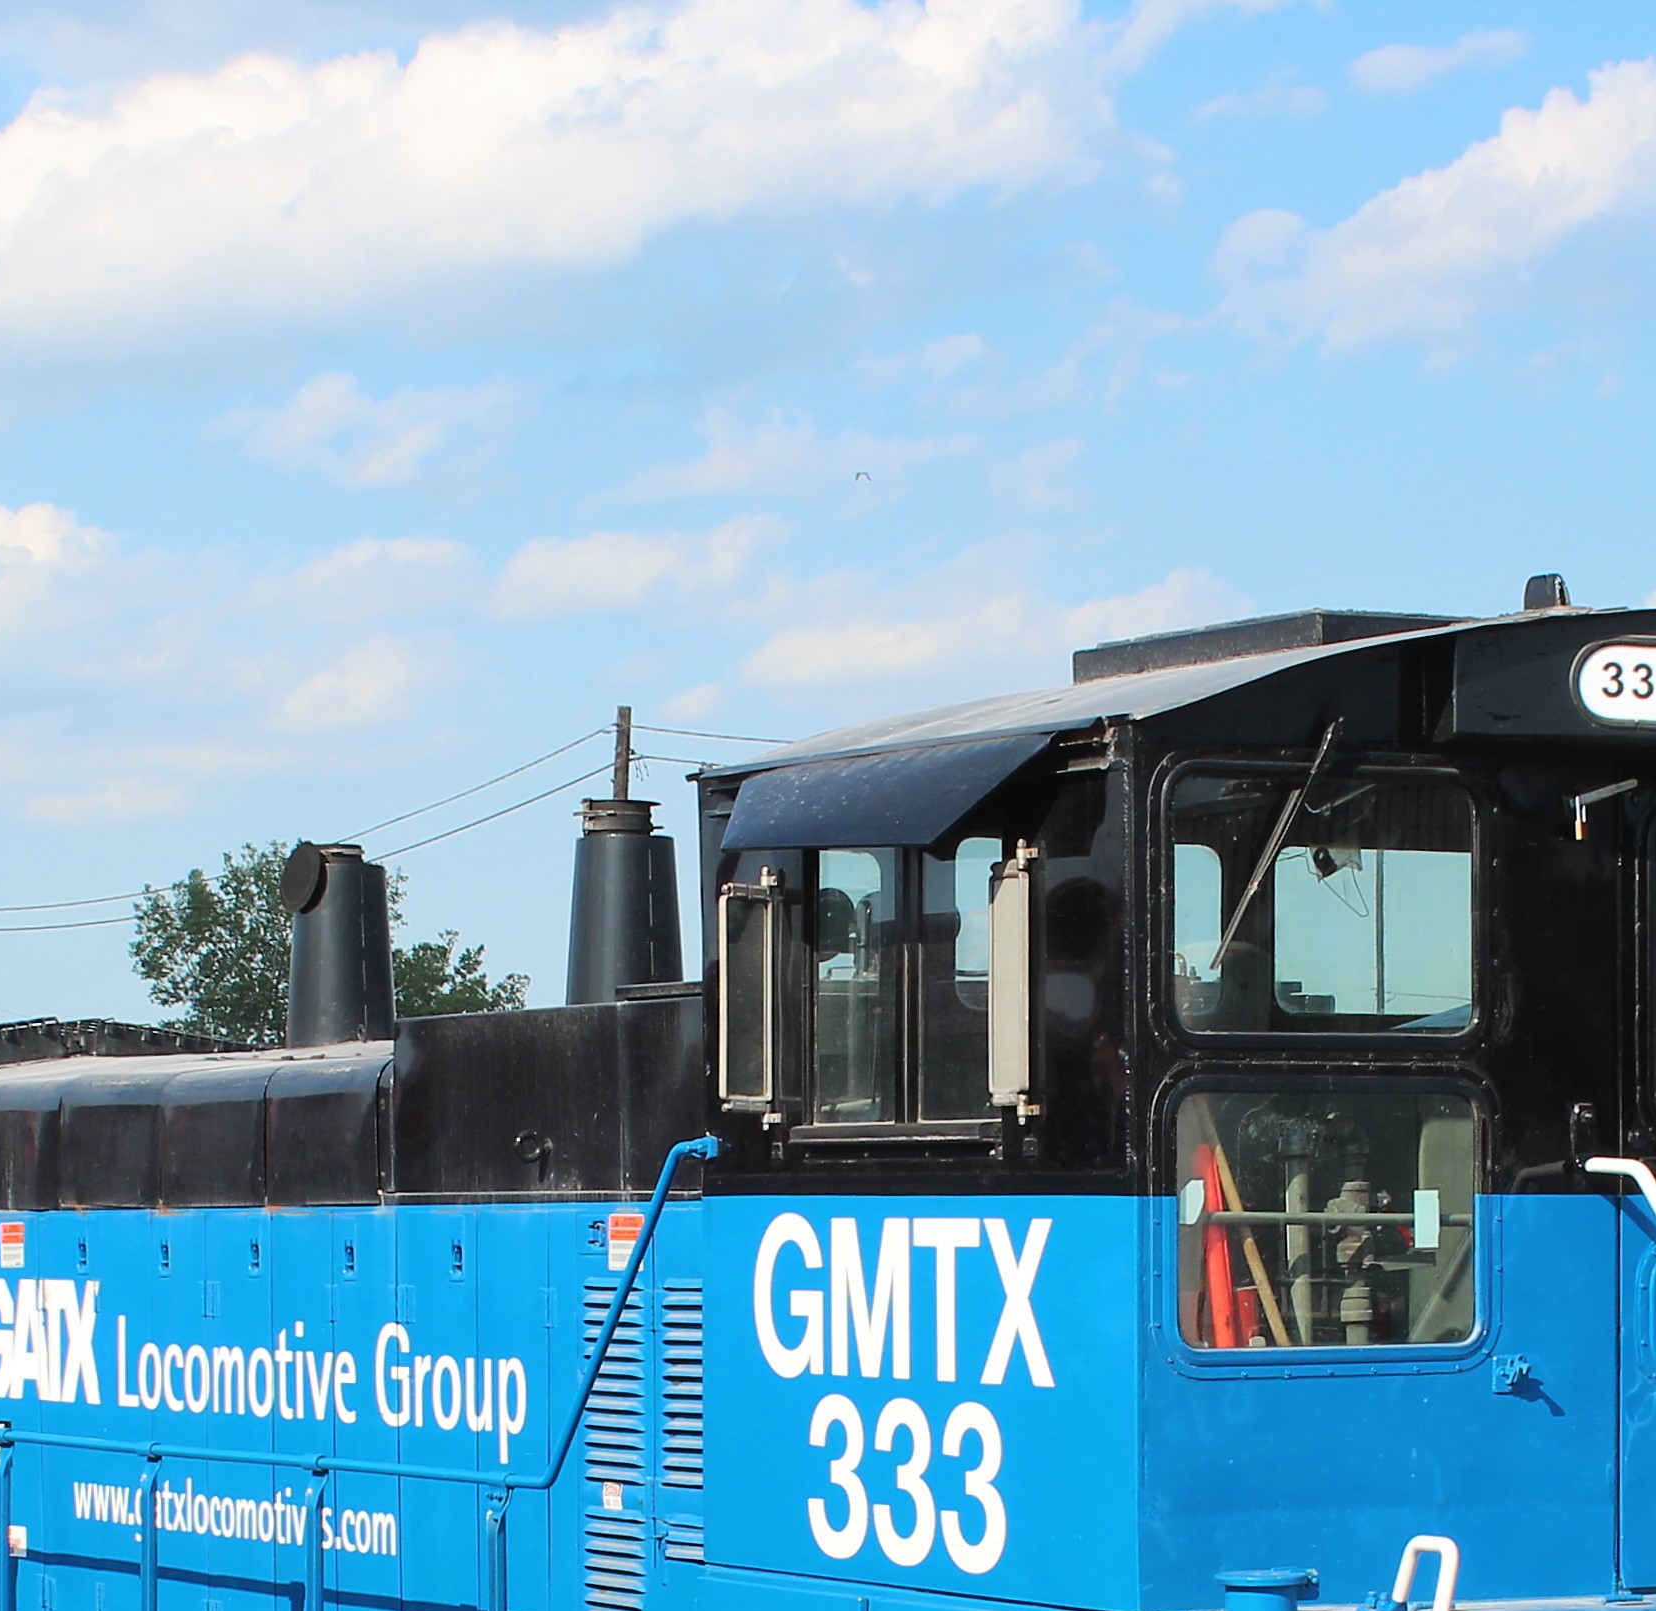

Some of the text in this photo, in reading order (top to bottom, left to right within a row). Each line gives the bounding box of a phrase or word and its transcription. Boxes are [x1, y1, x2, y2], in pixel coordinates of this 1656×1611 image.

[752, 1211, 1056, 1388] GMTX
[116, 1314, 357, 1424] Locomotive
[374, 1320, 528, 1465] Group
[73, 1477, 398, 1556] www.txlocomotivs.com
[807, 1393, 1008, 1575] 333
